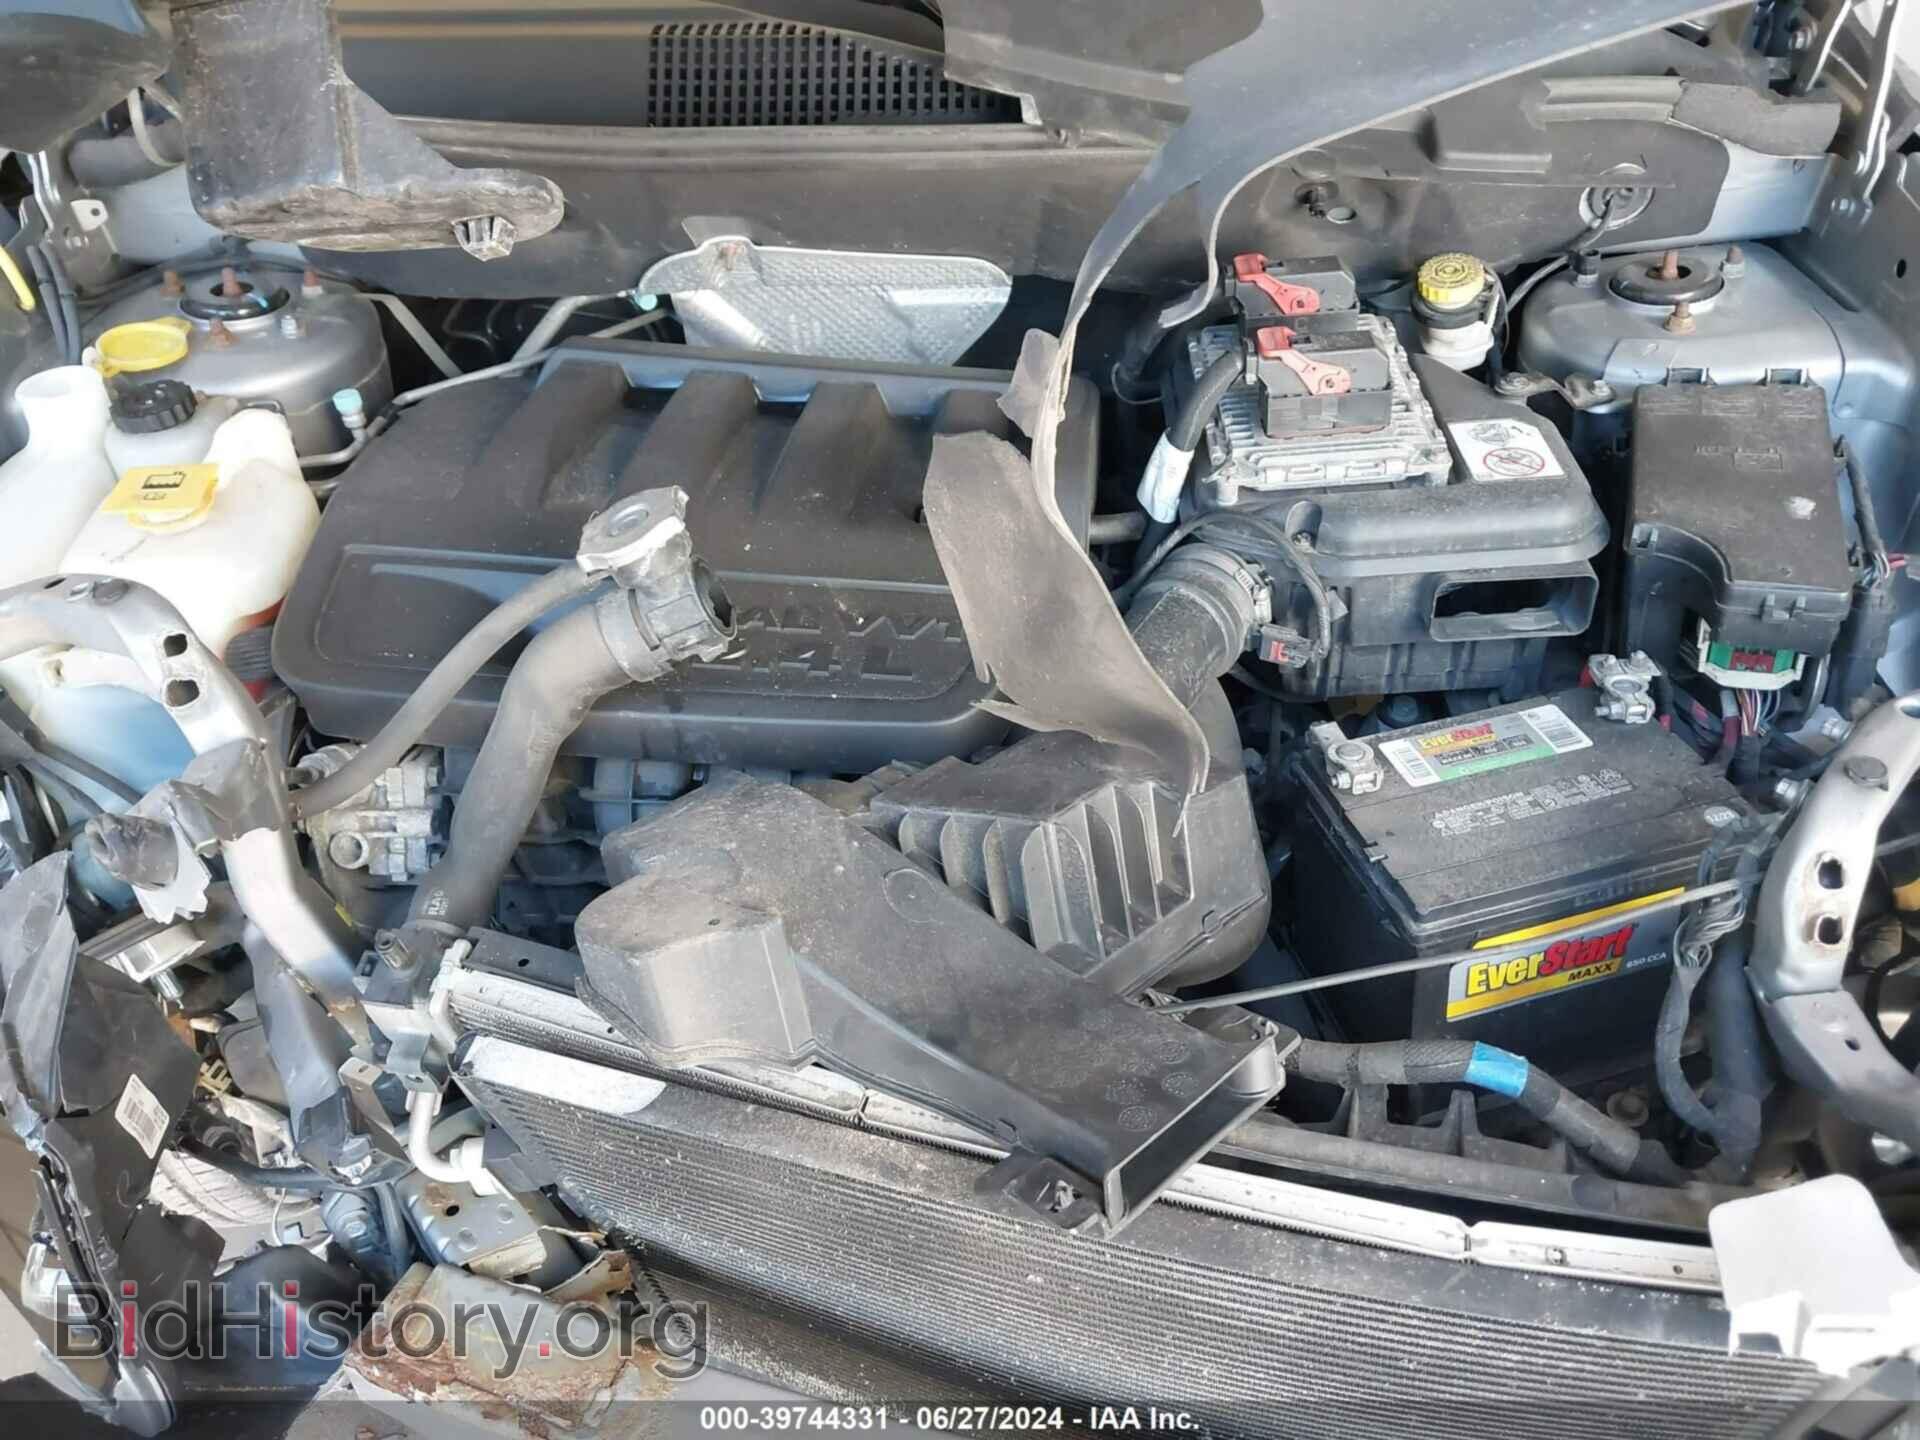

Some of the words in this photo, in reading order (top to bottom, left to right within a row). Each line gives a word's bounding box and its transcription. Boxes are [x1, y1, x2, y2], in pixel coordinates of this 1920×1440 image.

[1467, 923, 1634, 997] EverStart
[1647, 952, 1666, 964] CCA
[1567, 961, 1614, 982] MAXX
